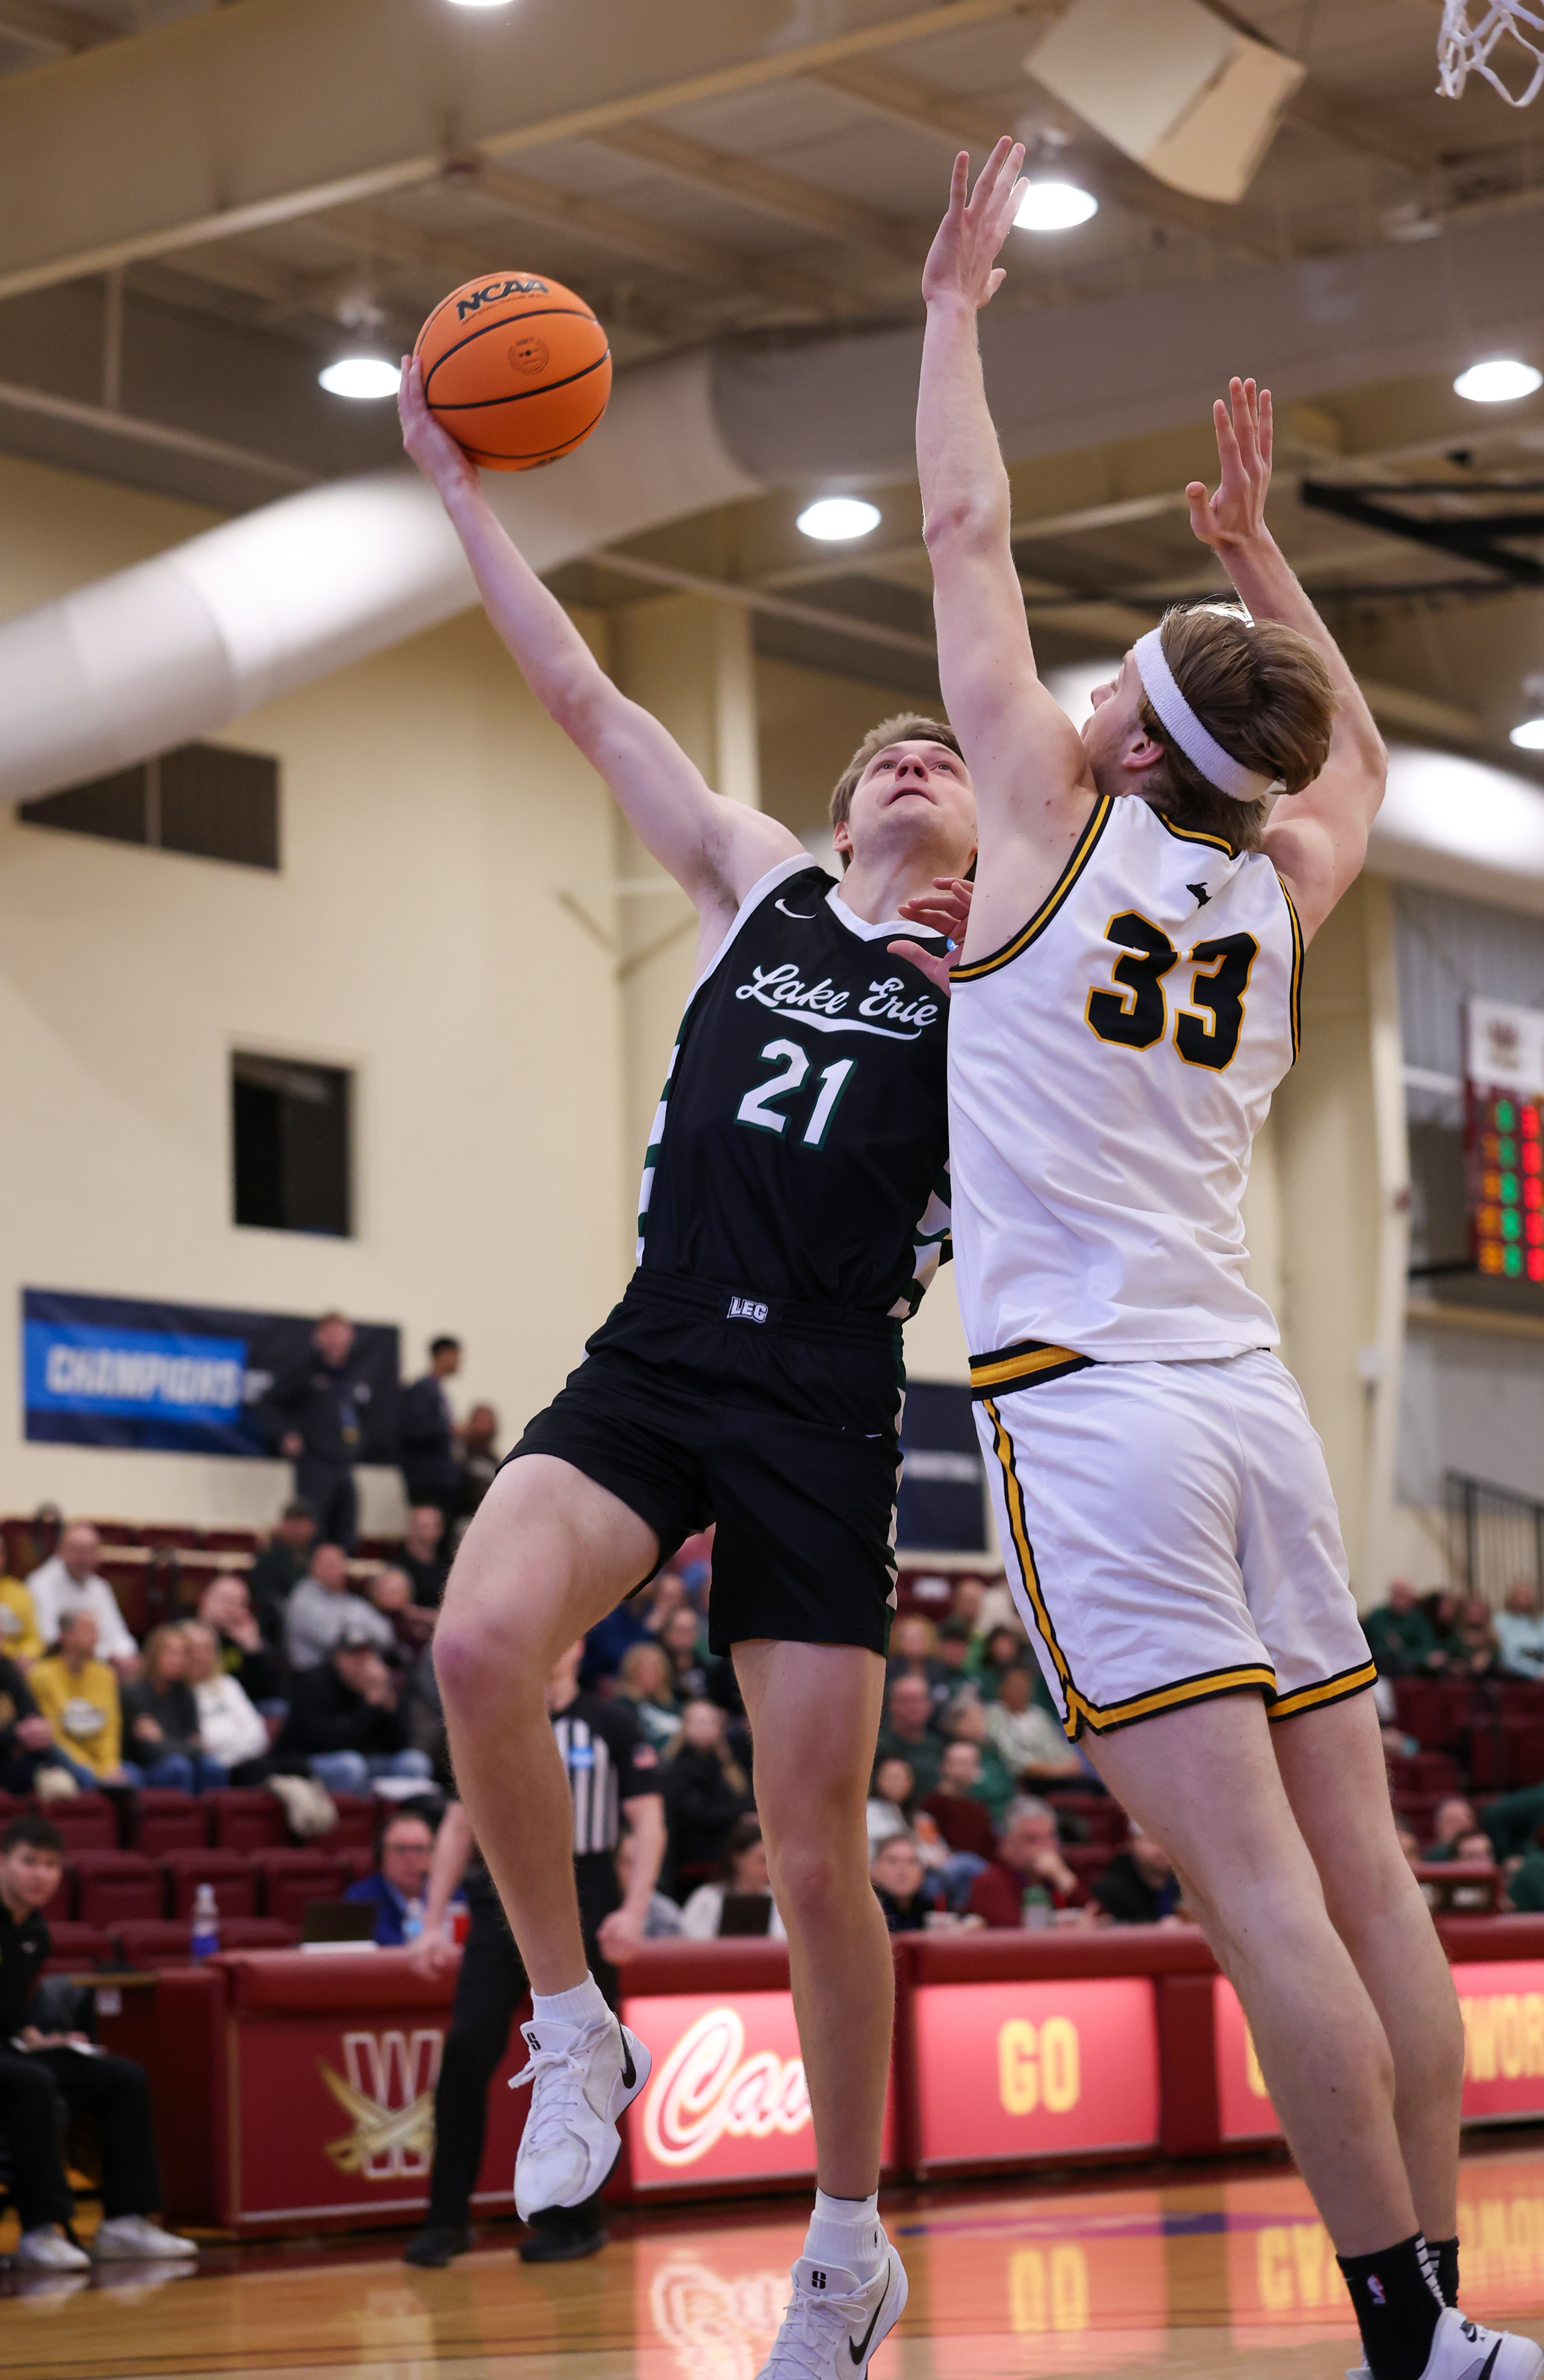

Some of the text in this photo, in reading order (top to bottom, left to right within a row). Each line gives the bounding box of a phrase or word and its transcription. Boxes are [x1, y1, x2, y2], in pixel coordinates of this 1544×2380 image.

[456, 279, 550, 322] NCAA
[735, 963, 938, 1026] Lake Erie
[1084, 908, 1261, 1074] 33
[733, 1036, 858, 1152] 21
[997, 2015, 1081, 2116] GO
